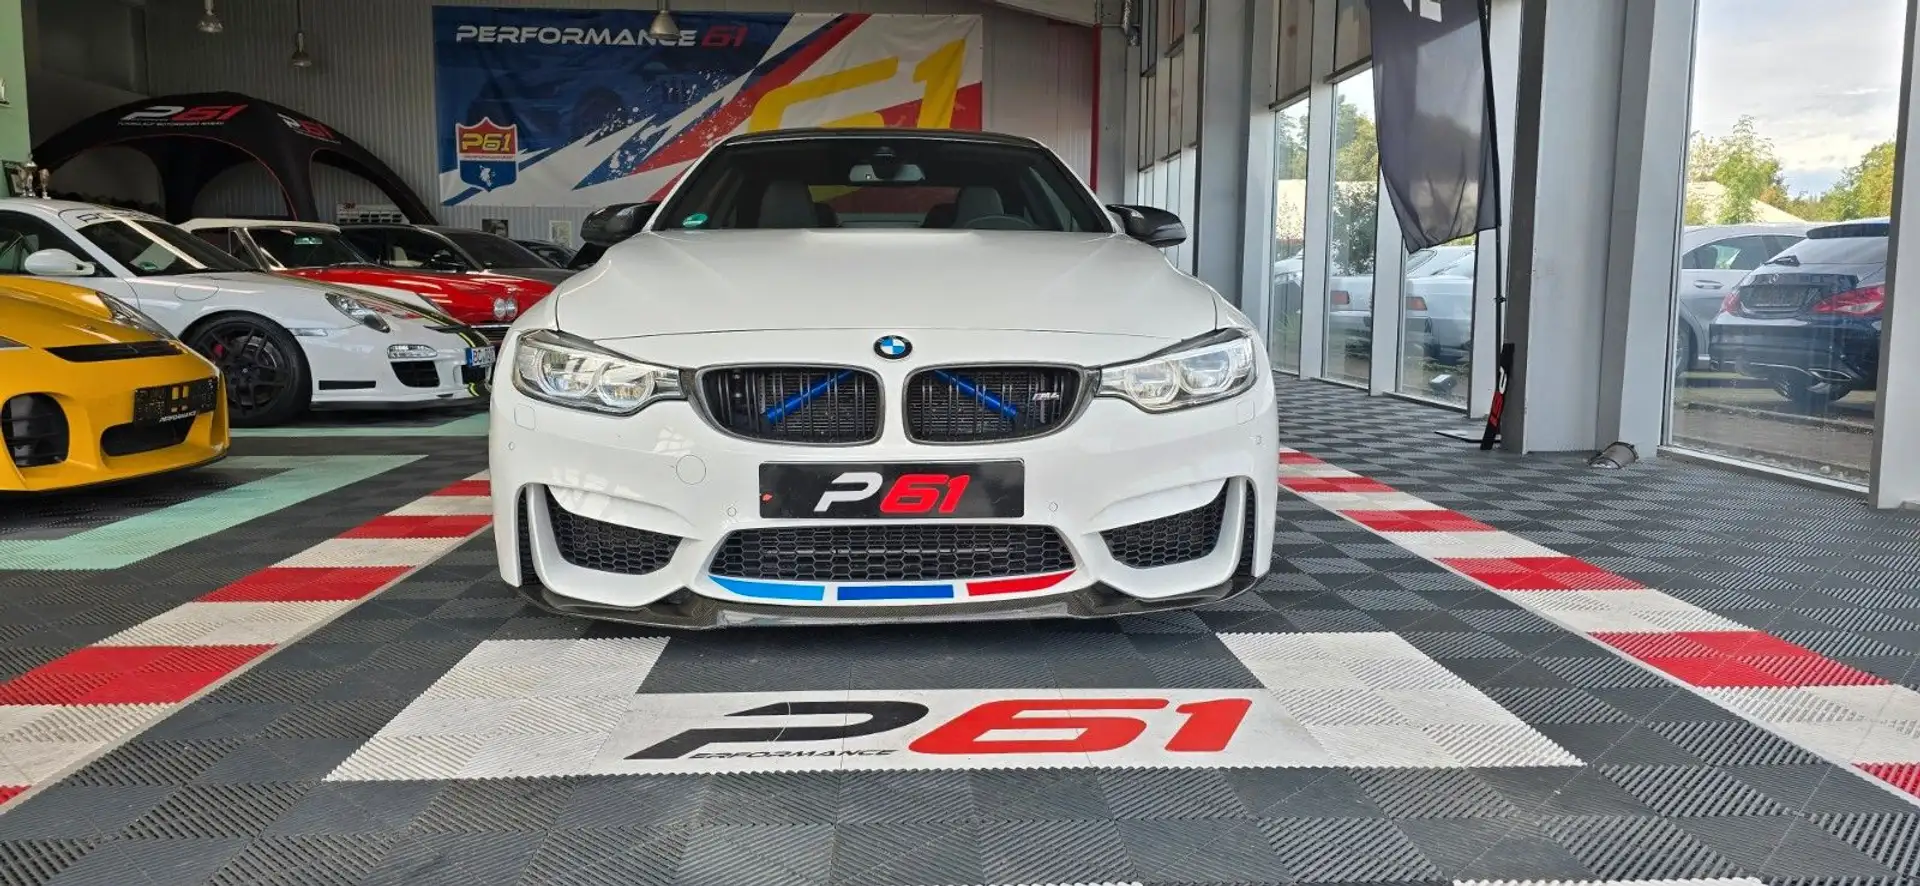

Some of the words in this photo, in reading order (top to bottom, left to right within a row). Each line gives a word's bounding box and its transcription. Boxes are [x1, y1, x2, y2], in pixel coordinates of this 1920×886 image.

[701, 25, 748, 47] 61
[120, 104, 248, 121] P61
[461, 132, 512, 153] P61
[813, 472, 971, 514] P61
[623, 699, 1253, 760] P61
